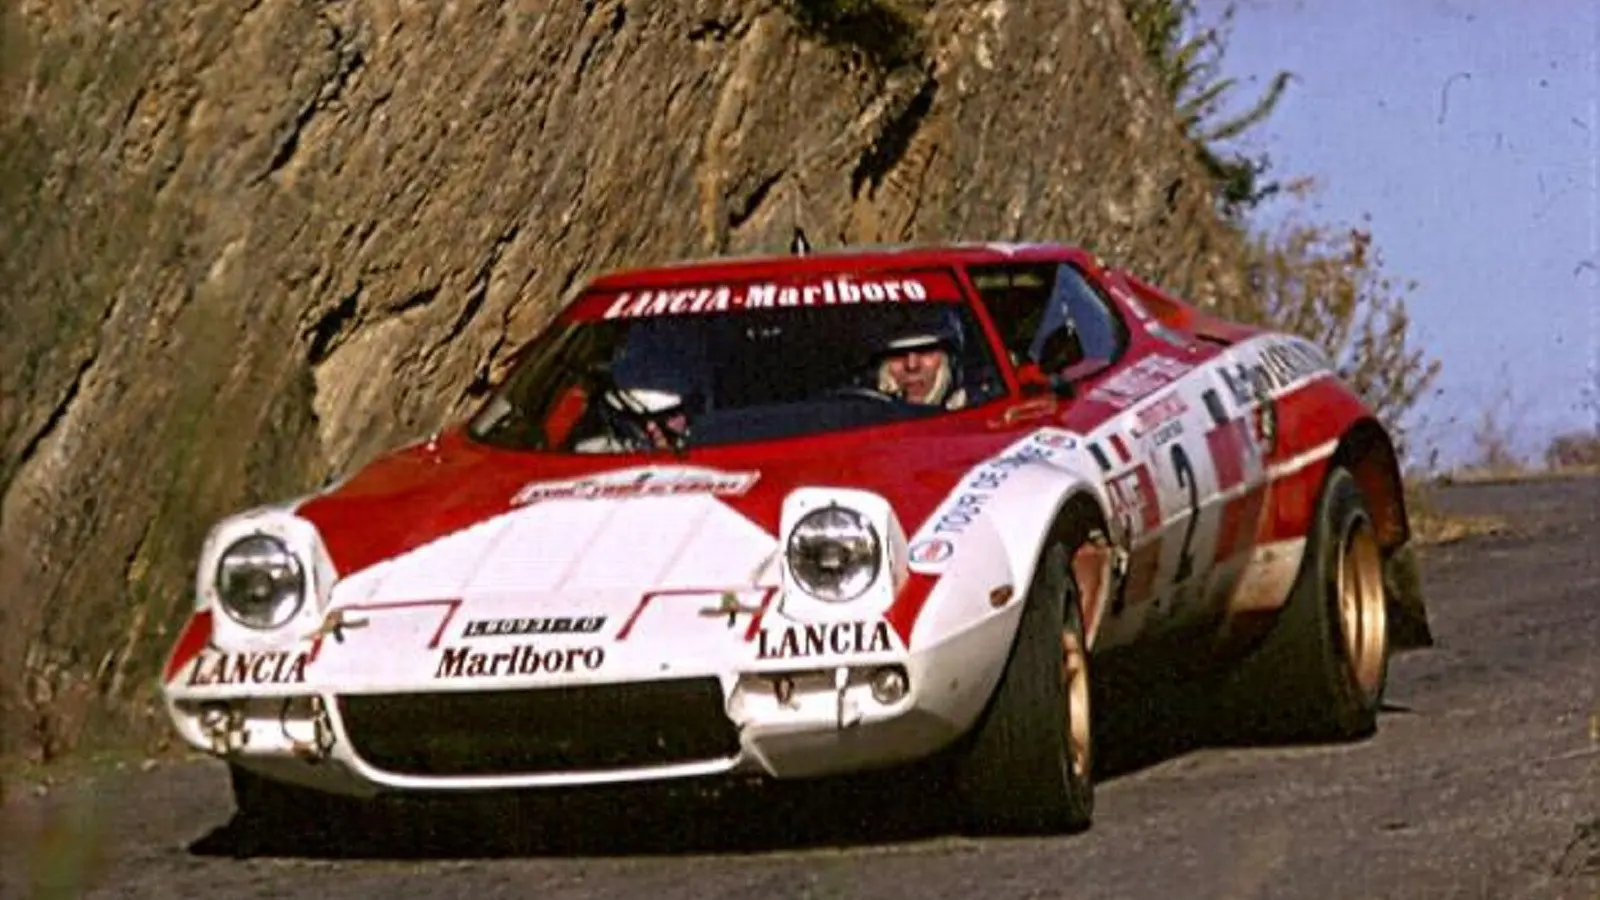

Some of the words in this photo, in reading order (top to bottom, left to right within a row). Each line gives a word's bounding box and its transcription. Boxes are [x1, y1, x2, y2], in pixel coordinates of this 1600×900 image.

[756, 621, 893, 660] LANCIA
[187, 650, 307, 686] LANCIA
[435, 645, 605, 679] Marlboro
